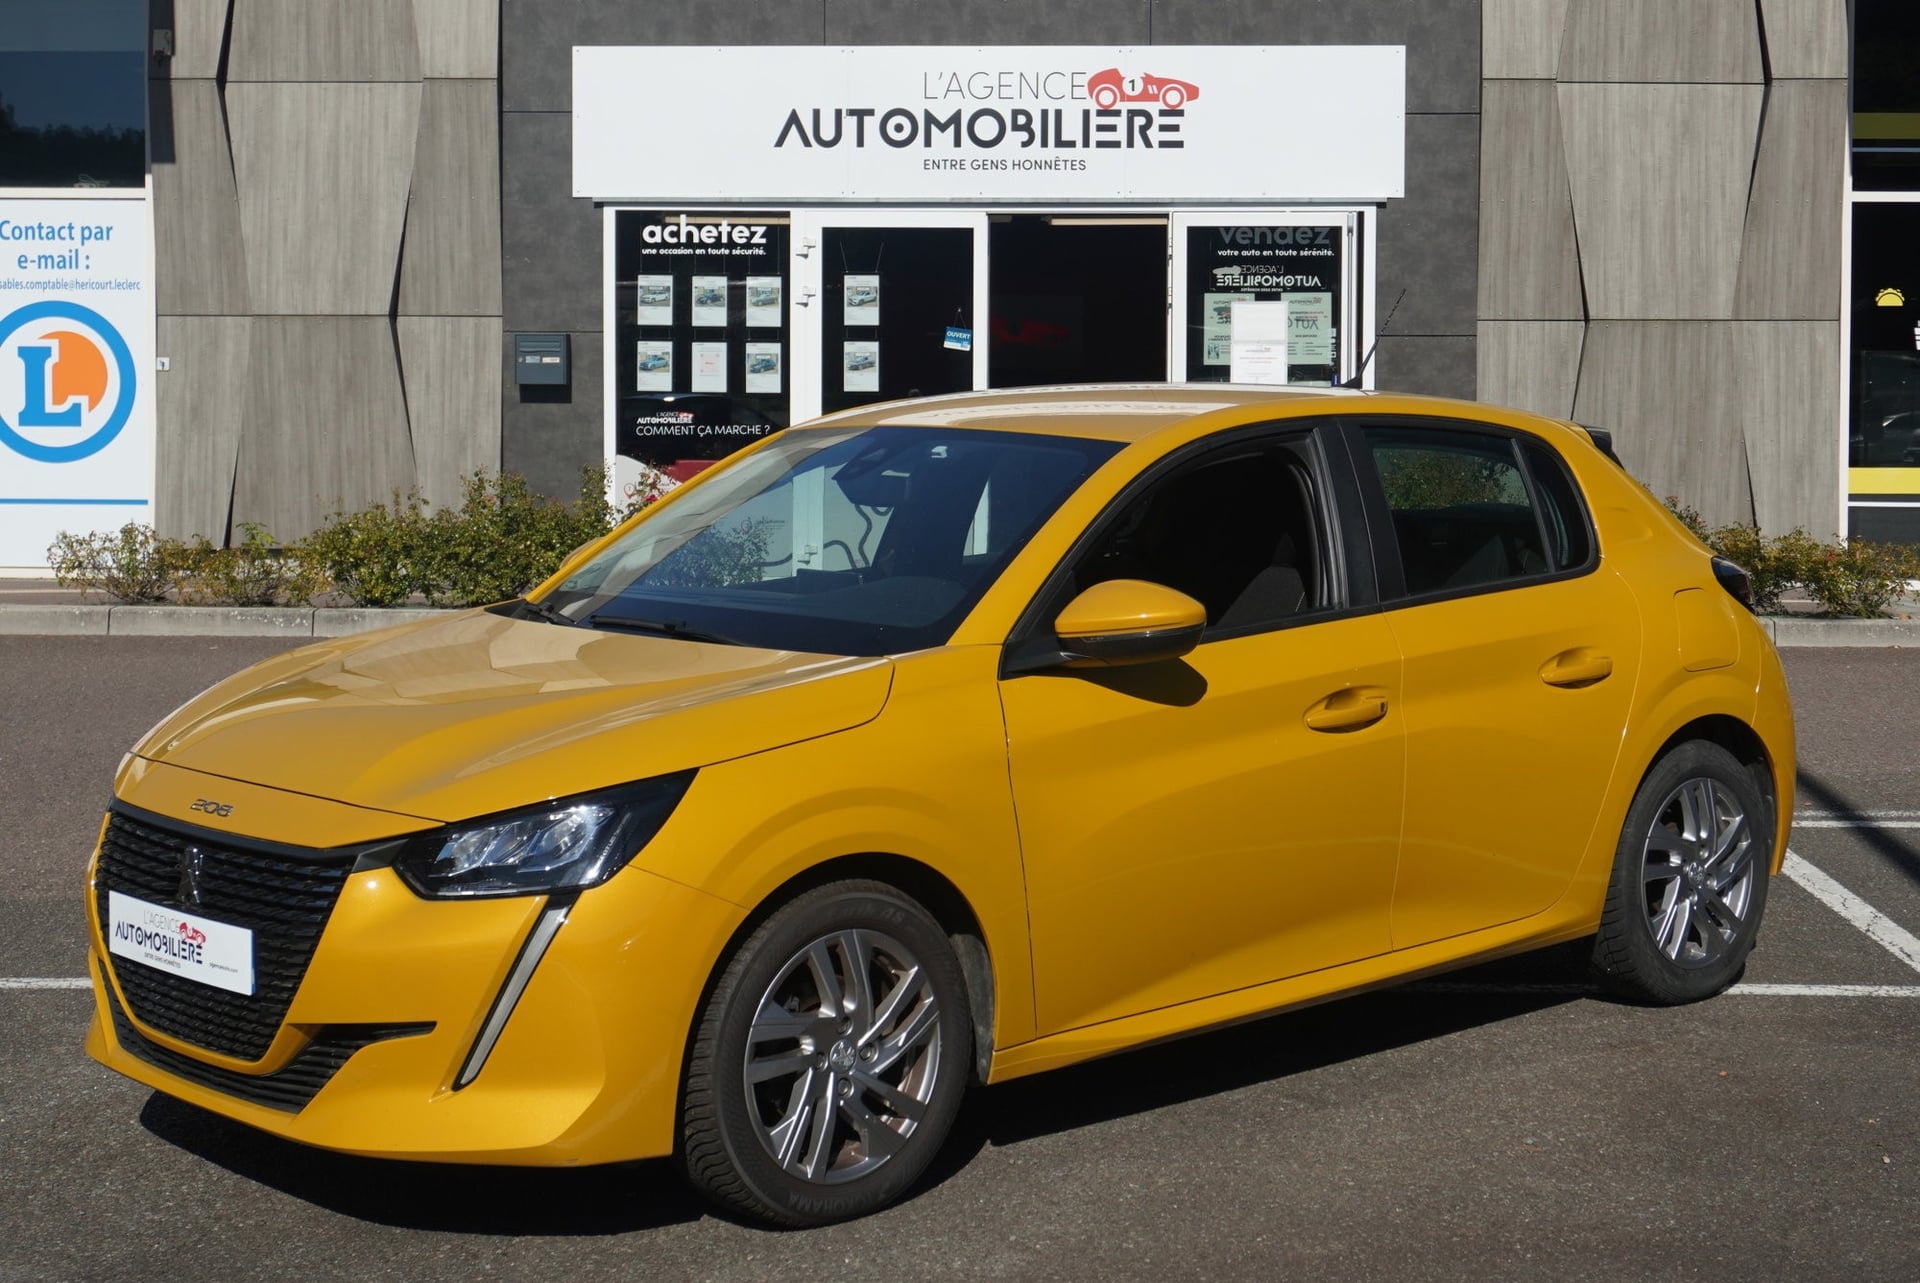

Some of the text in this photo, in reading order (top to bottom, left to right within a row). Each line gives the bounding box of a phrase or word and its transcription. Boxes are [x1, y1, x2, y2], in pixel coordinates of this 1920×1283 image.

[924, 71, 1088, 100] L'AGENCE
[1128, 79, 1136, 92] 1
[774, 107, 1185, 149] AUTOMOBILIERE
[923, 156, 1087, 170] ENTRE GENS HONNÊTES
[0, 220, 113, 247] Contact par
[642, 214, 767, 244] achetez
[1219, 226, 1331, 245] vendez
[17, 248, 79, 270] e-mail
[659, 246, 693, 255] occasion
[708, 246, 730, 255] toute
[732, 246, 767, 255] sécurité.
[1299, 247, 1335, 257] sérénité.
[946, 330, 971, 340] OUVERT
[17, 346, 82, 427] L
[635, 424, 770, 437] COMMENT ÇA MARCHE ?
[190, 798, 234, 818] 208
